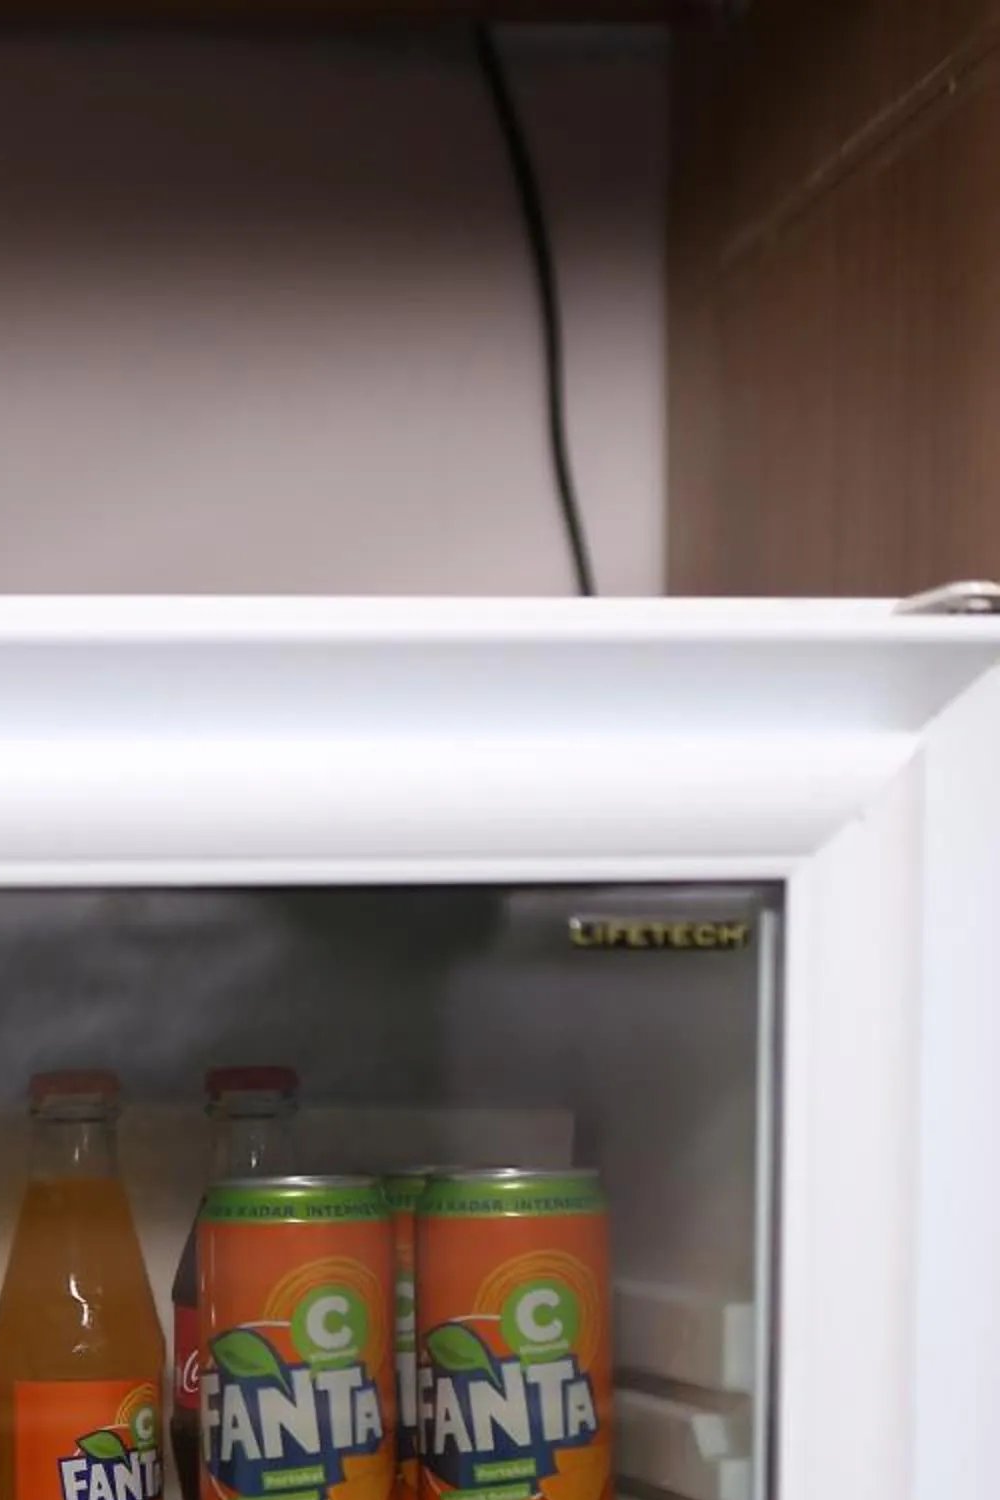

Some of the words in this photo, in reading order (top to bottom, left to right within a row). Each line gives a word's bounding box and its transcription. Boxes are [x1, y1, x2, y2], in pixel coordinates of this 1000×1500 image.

[306, 1295, 355, 1349] C
[515, 1288, 564, 1342] C
[200, 1366, 383, 1462] FANTA
[417, 1359, 597, 1455] FANTA
